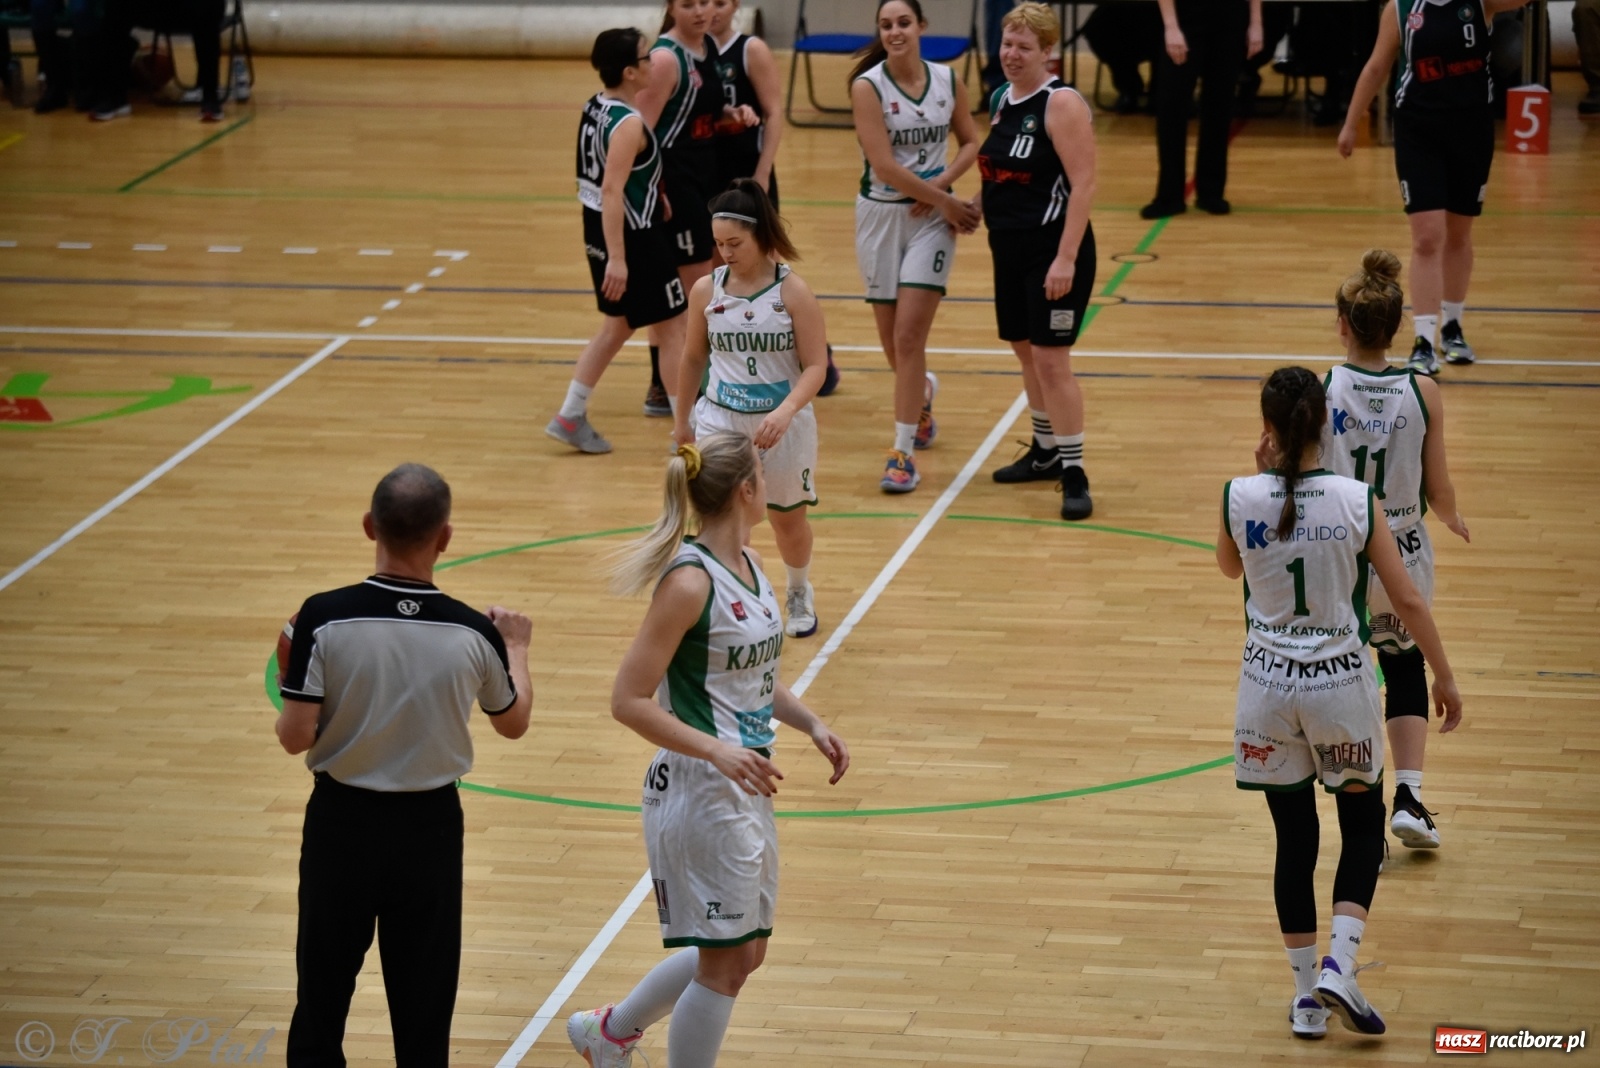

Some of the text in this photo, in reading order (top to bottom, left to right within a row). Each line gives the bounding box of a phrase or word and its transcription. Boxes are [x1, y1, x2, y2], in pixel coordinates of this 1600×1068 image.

[1463, 23, 1476, 48] 9
[1514, 97, 1542, 139] 5
[580, 123, 600, 180] 13
[918, 148, 927, 165] 6
[1009, 134, 1034, 159] 10
[677, 230, 694, 256] 4
[933, 250, 945, 273] 6
[665, 278, 685, 309] 13
[746, 357, 758, 376] 8
[1353, 384, 1403, 395] #REPREZENTKTW
[1350, 445, 1387, 499] 11
[1286, 557, 1310, 616] 1
